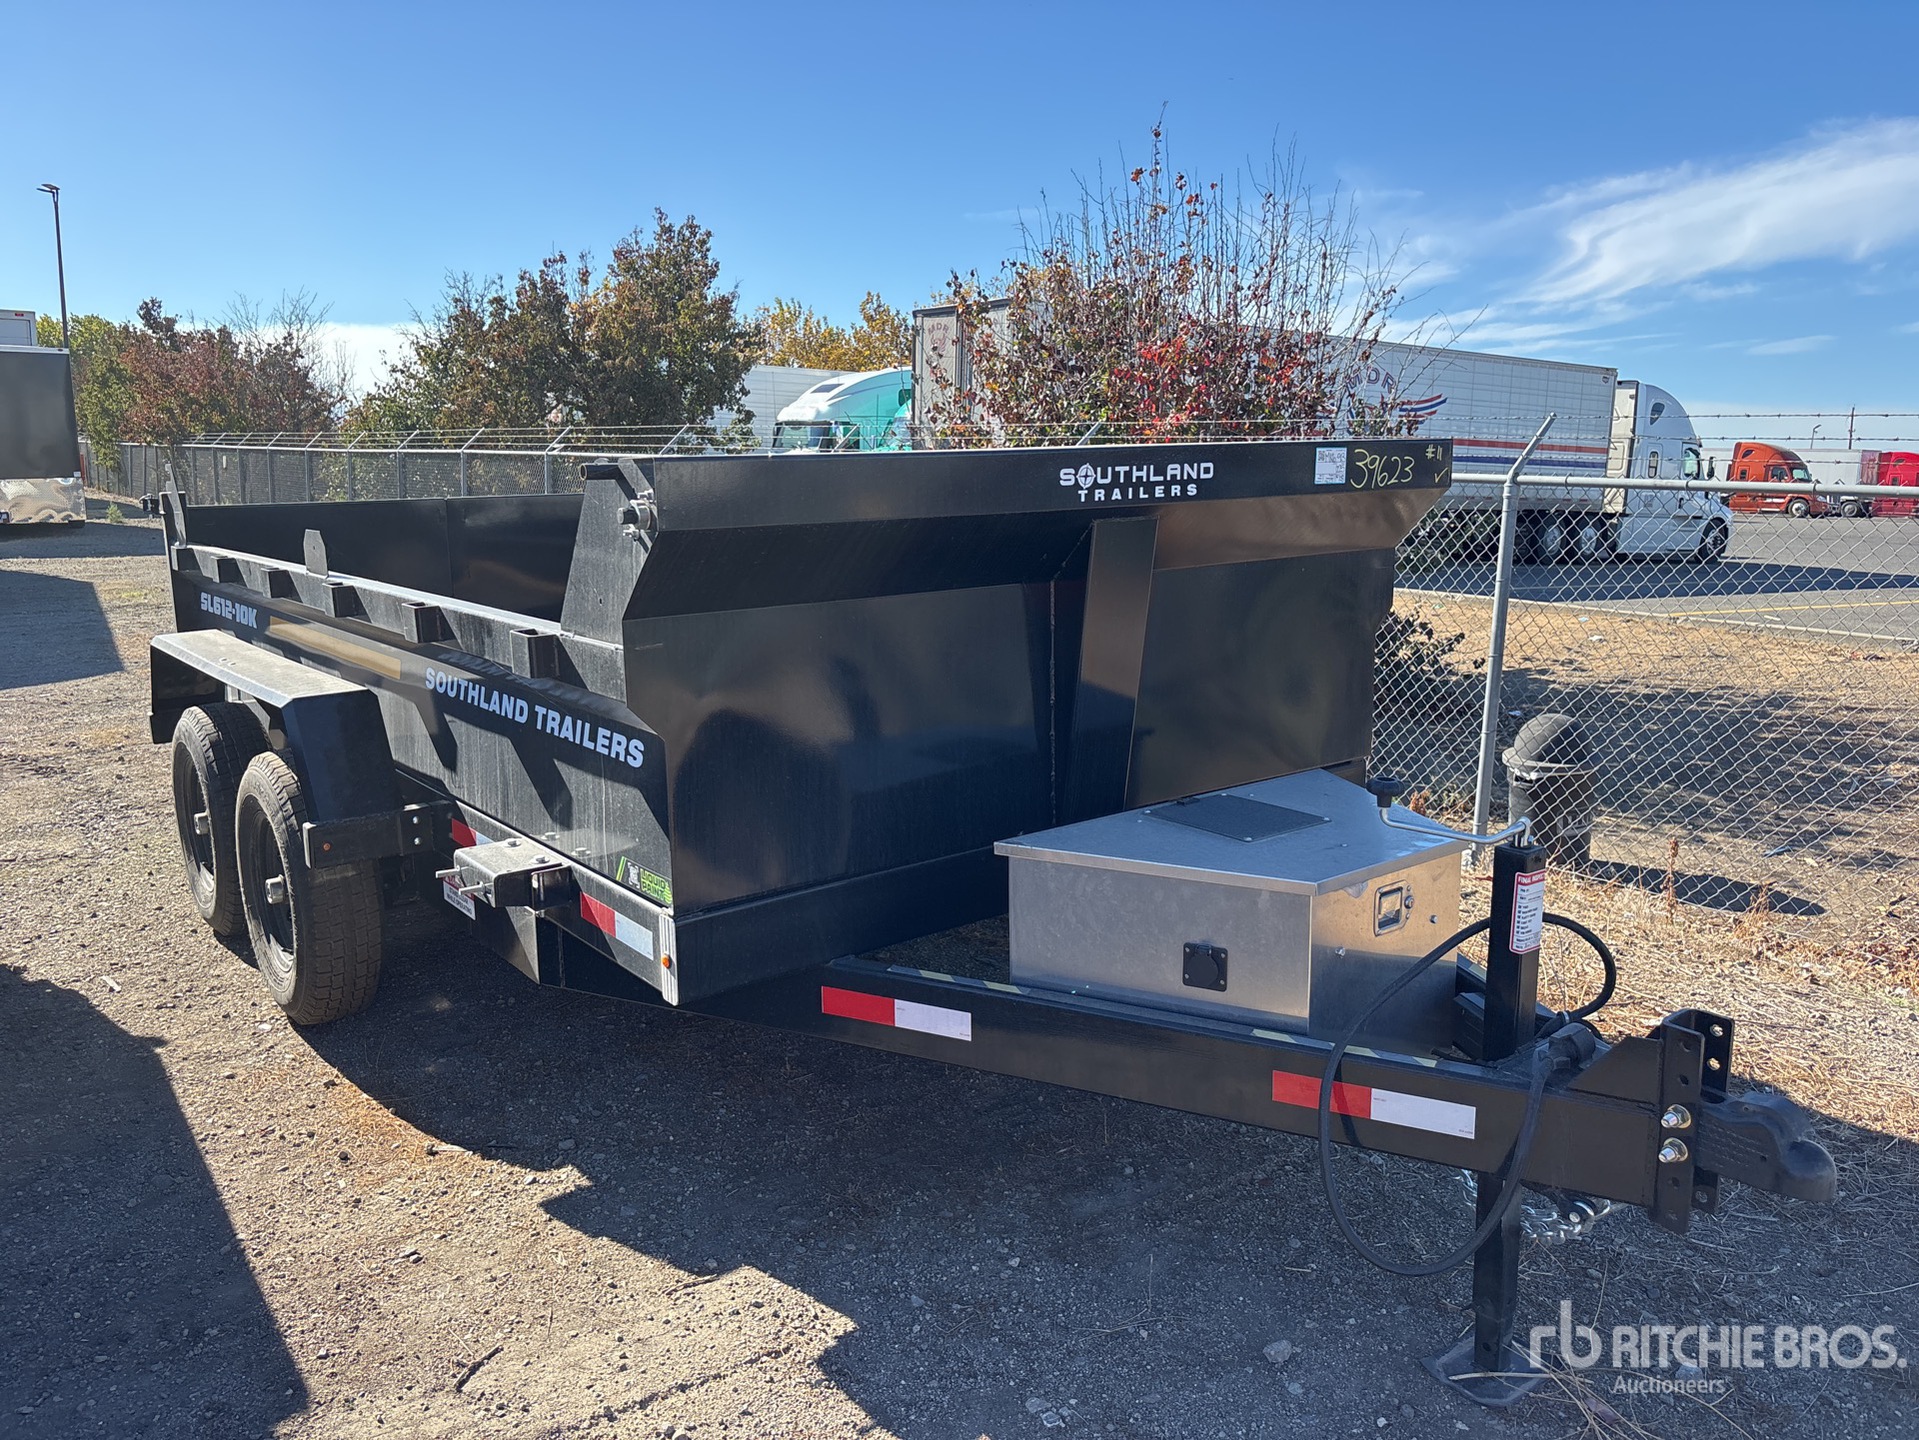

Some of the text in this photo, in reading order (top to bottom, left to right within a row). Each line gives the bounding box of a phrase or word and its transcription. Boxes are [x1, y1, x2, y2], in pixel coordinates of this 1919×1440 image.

[1059, 462, 1214, 488] SOUTHLAND
[1350, 449, 1415, 489] 39623
[1078, 484, 1197, 502] TRAILERS
[200, 591, 258, 629] SL612-10K
[425, 667, 645, 769] SOUTHLAND TRAILERS
